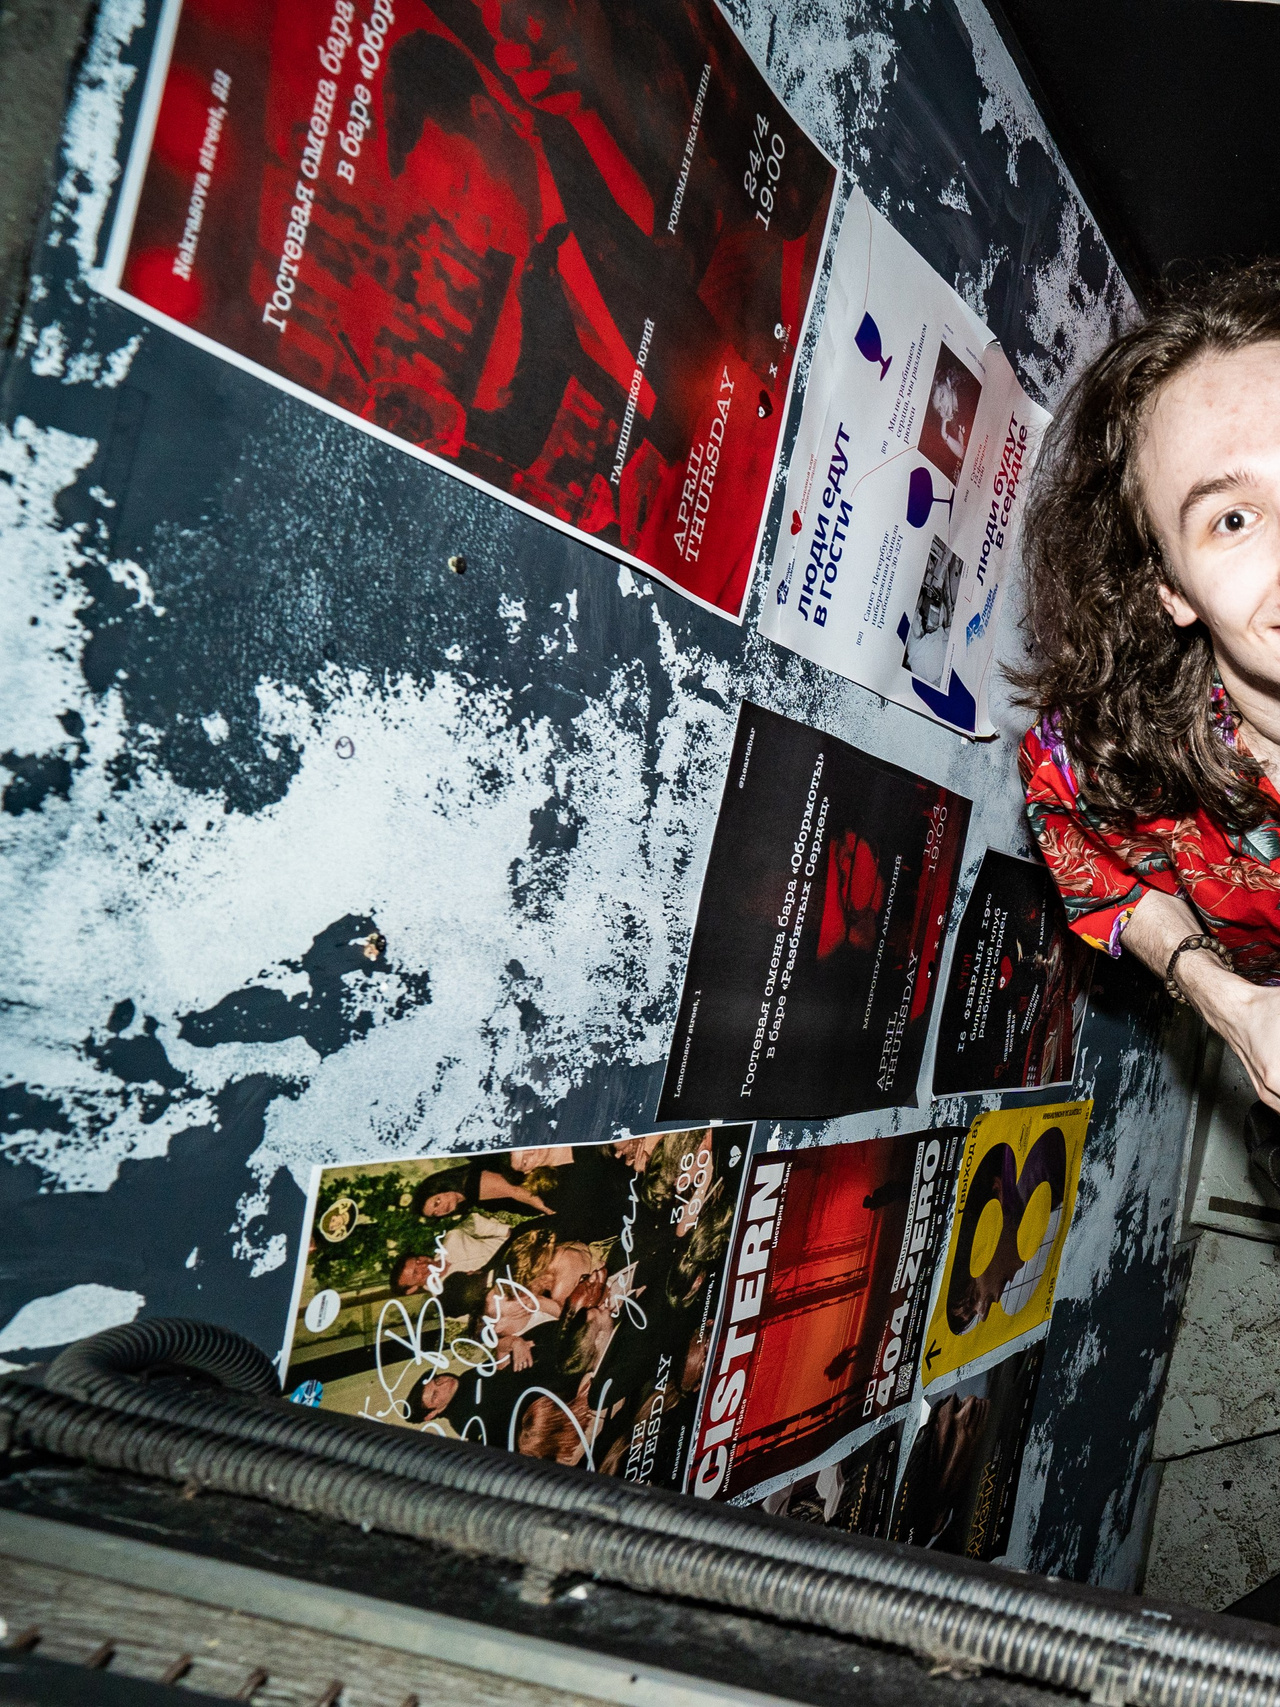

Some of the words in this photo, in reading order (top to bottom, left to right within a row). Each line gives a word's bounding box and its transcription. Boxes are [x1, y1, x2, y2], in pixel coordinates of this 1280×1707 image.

[317, 0, 355, 75] бара
[360, 0, 396, 80] «Обор
[211, 69, 232, 103] 22
[301, 79, 337, 179] смена
[338, 84, 371, 157] баре
[199, 107, 227, 171] street,
[337, 160, 355, 185] в
[667, 156, 691, 235] РОКСМАН
[685, 64, 711, 157] ЕКАТЕРИНА
[744, 113, 769, 199] 24/4
[755, 133, 785, 231] 19:00
[173, 172, 210, 280] Nekrasova
[262, 181, 315, 333] Гостевая
[610, 369, 643, 485] ГАЛИШНИКОВ
[636, 318, 655, 369] ЮРИЙ
[888, 413, 897, 432] Мы
[894, 398, 901, 412] не
[898, 341, 916, 398] разбиваем
[897, 400, 910, 438] сердца,
[907, 380, 914, 397] мы
[911, 323, 927, 380] разливаем
[903, 406, 916, 445] рюмки
[673, 443, 704, 556] APRIL
[685, 365, 735, 562] THURSDAY
[976, 500, 999, 586] люди
[993, 411, 1018, 496] будут
[798, 513, 830, 621] люди
[822, 422, 850, 509] едут
[819, 499, 853, 600] гости
[871, 563, 889, 626] набережная
[886, 525, 900, 561] Канала
[877, 571, 895, 629] Грибоедова
[739, 727, 755, 789] @heartsbar
[805, 796, 830, 876] Сердец»
[923, 804, 940, 857] 10/4
[928, 807, 947, 873] 19:00
[740, 1001, 771, 1097] Гостевая
[764, 931, 786, 996] смена
[777, 879, 797, 927] бара
[791, 753, 824, 874] «Обормоты»
[780, 881, 812, 990] «Разбитых
[862, 939, 885, 1029] МОКРОПУЛО
[882, 855, 902, 936] АНАТОЛИЙ
[768, 995, 786, 1041] баре
[884, 949, 918, 1091] THURSDAY
[964, 940, 985, 1020] ФЕВРАЛЯ
[970, 947, 994, 1041] бильярдный
[990, 908, 1001, 942] клуб
[978, 968, 997, 1038] разбитых
[993, 912, 1008, 965] сердец
[674, 1036, 692, 1098] Lomonosov
[688, 999, 700, 1034] street,
[766, 1046, 775, 1058] в
[876, 1011, 898, 1091] APRIL
[670, 1151, 695, 1225] 3/06
[681, 1147, 712, 1231] 19:00
[771, 1205, 784, 1248] Цистерна
[781, 1162, 793, 1194] Т-Банк
[876, 1139, 940, 1407] 404.ZERO
[897, 1215, 914, 1266] MUSEUM
[694, 1162, 785, 1500] CISTERN
[696, 1280, 715, 1344] Lomonosova,
[1045, 1277, 1056, 1314] 28.08
[722, 1443, 737, 1492] Multimedia
[732, 1427, 740, 1441] Art
[736, 1399, 747, 1425] Space
